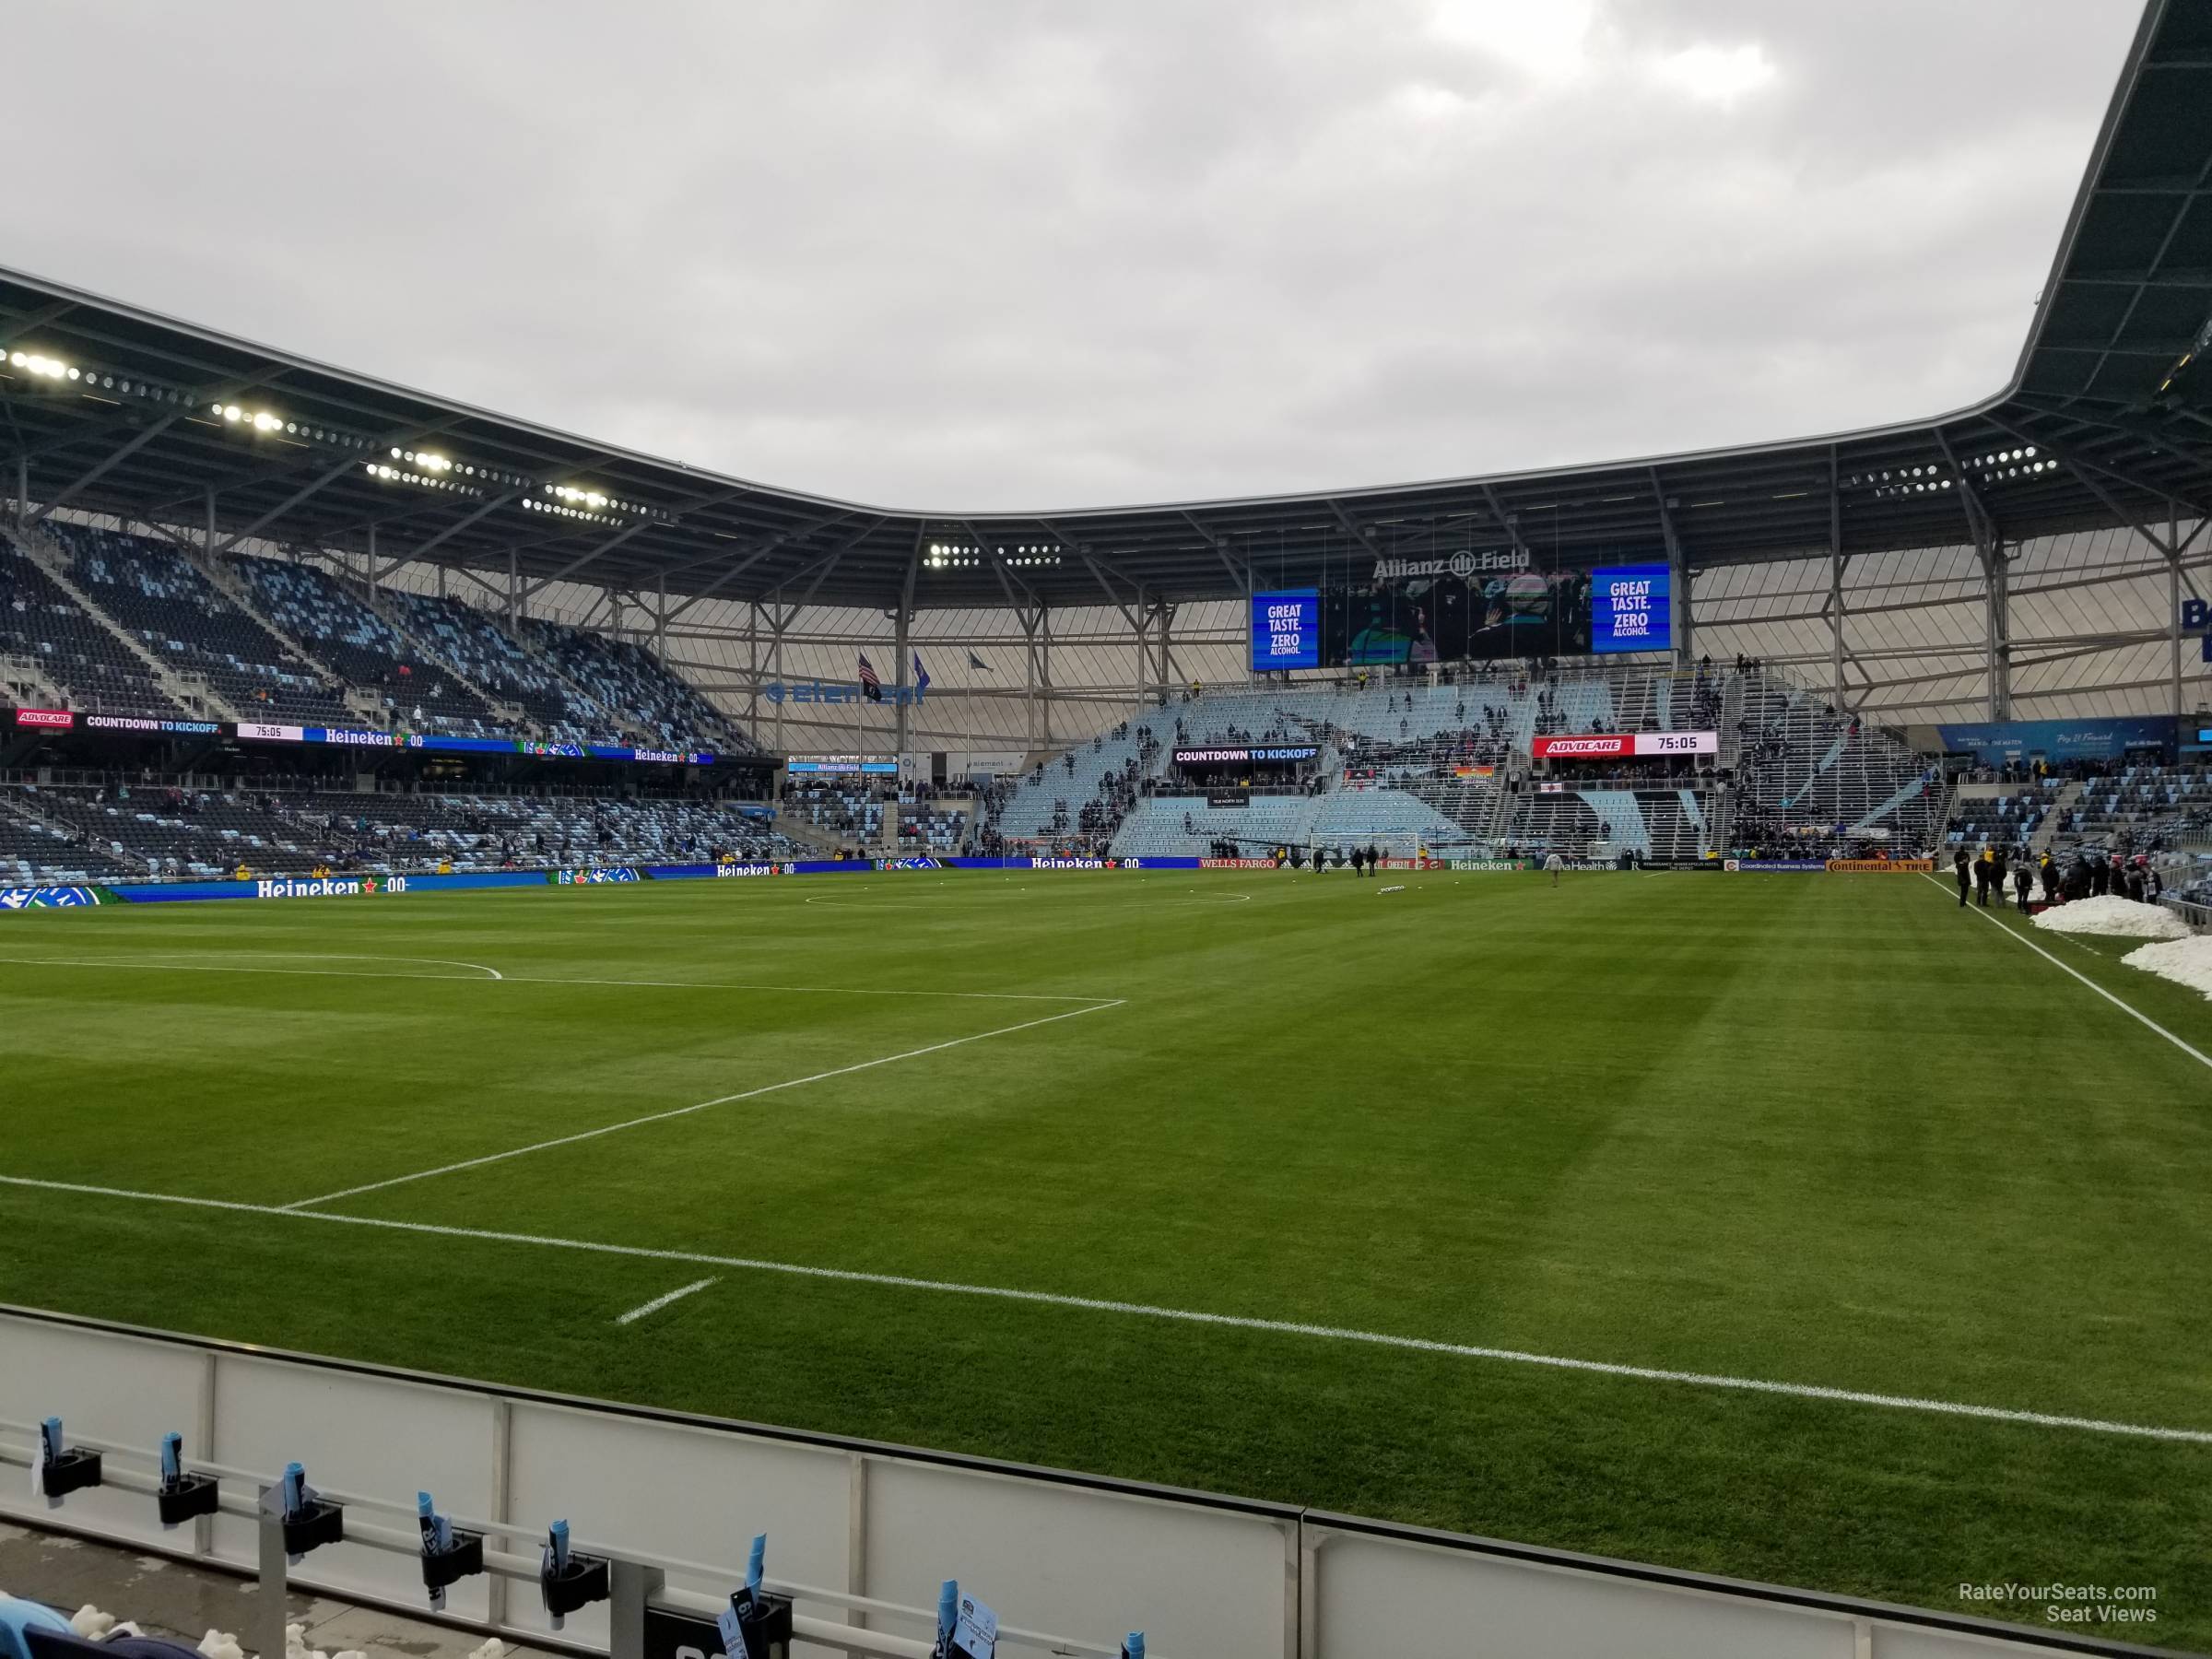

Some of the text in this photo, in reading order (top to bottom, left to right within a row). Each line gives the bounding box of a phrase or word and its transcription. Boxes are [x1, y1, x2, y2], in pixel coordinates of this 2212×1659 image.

[1373, 548, 1530, 579] Allianz Field
[1610, 581, 1652, 596] GREAT
[1610, 595, 1652, 611] TASTE.
[1267, 604, 1302, 618] GREAT
[1268, 618, 1302, 632] TASTE.
[1614, 612, 1649, 629] ZERO
[1270, 633, 1300, 647] ZERO
[18, 712, 72, 724] ADVOCARE
[87, 715, 159, 730] COUNTDOWN
[159, 721, 174, 731] TO
[256, 725, 282, 737] 75:05
[325, 728, 393, 746] Heineken
[1547, 739, 1621, 753] ADVOCARE
[1658, 736, 1697, 749] 75:05
[634, 748, 678, 762] Heineken
[1176, 748, 1317, 761] COUNTDOWN TO KICKOFF
[716, 863, 771, 877] Heineken
[1031, 857, 1103, 869] Heineken
[1201, 859, 1276, 868] WELLS FARGO
[1451, 860, 1512, 871] Heineken
[1571, 860, 1605, 871] Health
[1829, 860, 1892, 872] Continental
[257, 878, 359, 898] Heineken
